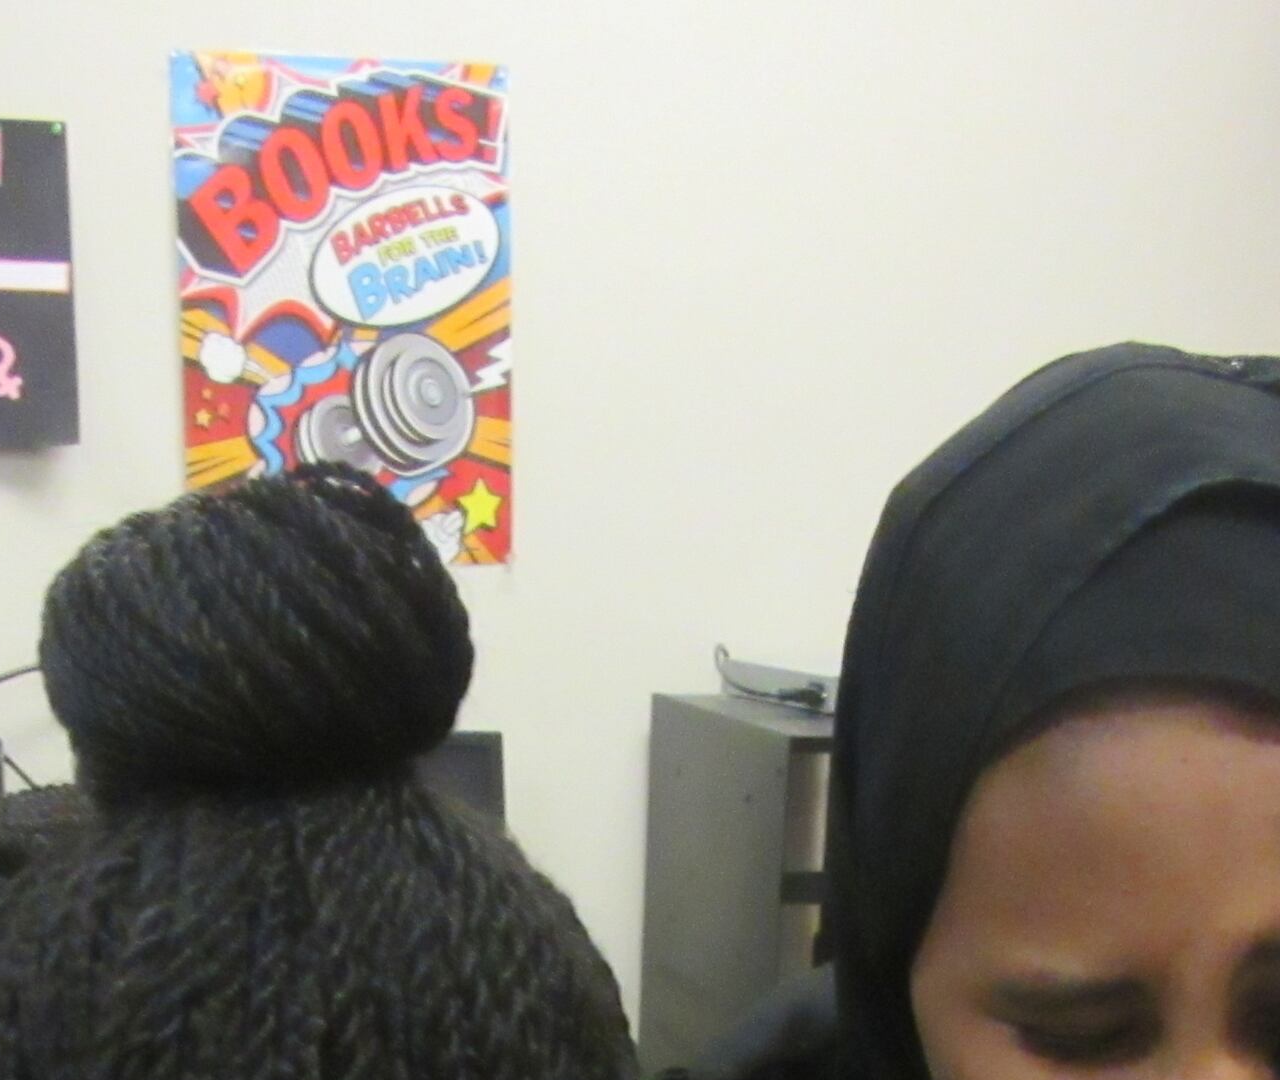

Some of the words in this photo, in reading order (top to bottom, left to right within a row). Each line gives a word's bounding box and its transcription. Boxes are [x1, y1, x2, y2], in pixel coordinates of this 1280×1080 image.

[188, 84, 503, 277] BOOKS!
[329, 192, 471, 265] BARBELLS
[376, 236, 417, 267] FOR
[419, 226, 461, 250] THE
[346, 239, 487, 320] BRAIN!
